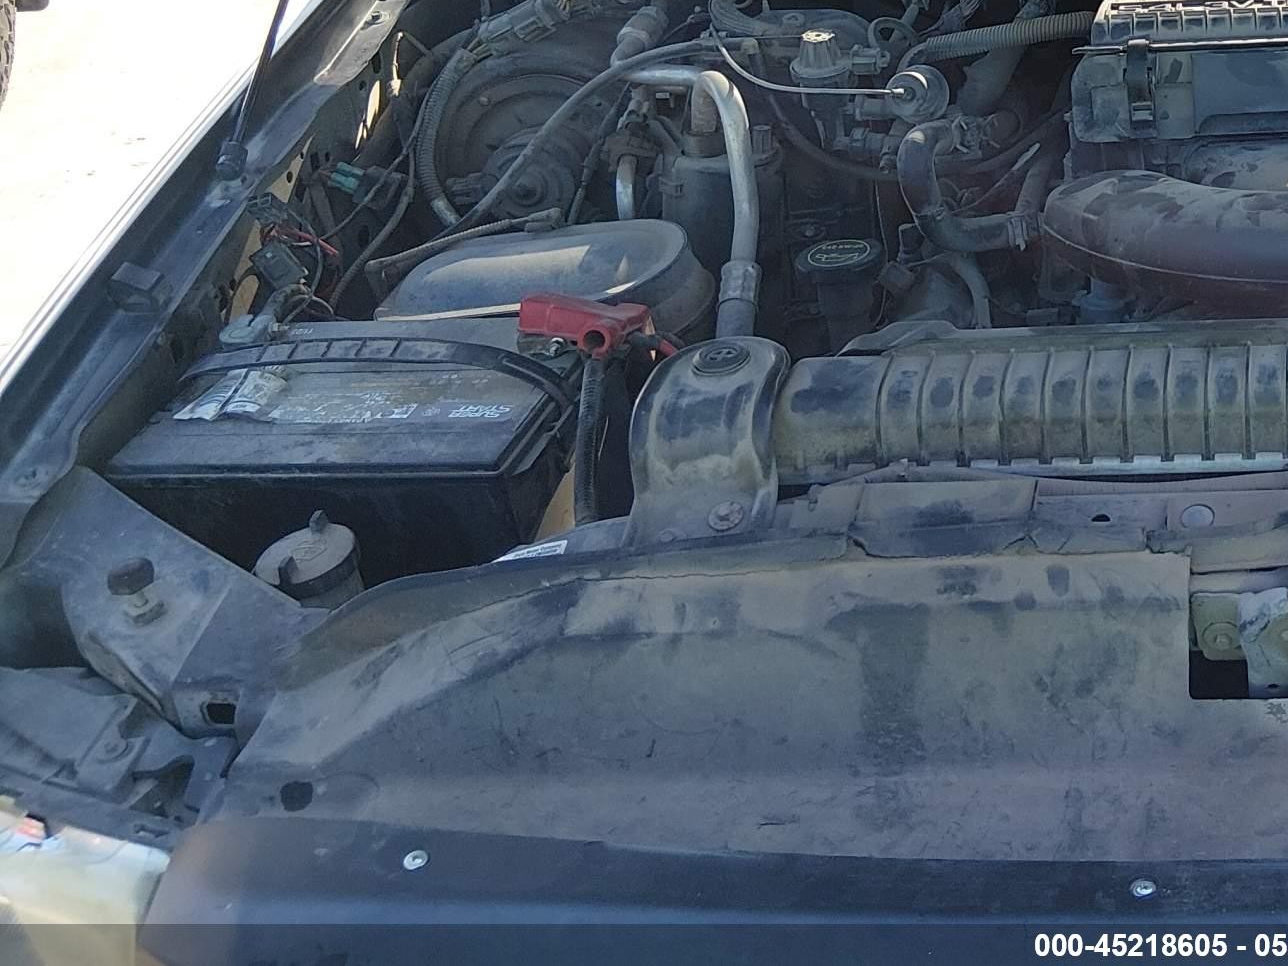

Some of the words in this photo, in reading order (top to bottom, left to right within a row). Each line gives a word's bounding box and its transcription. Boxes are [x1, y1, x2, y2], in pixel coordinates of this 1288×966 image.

[1203, 0, 1255, 10] 3V
[450, 403, 513, 413] START
[448, 409, 500, 418] SUPER
